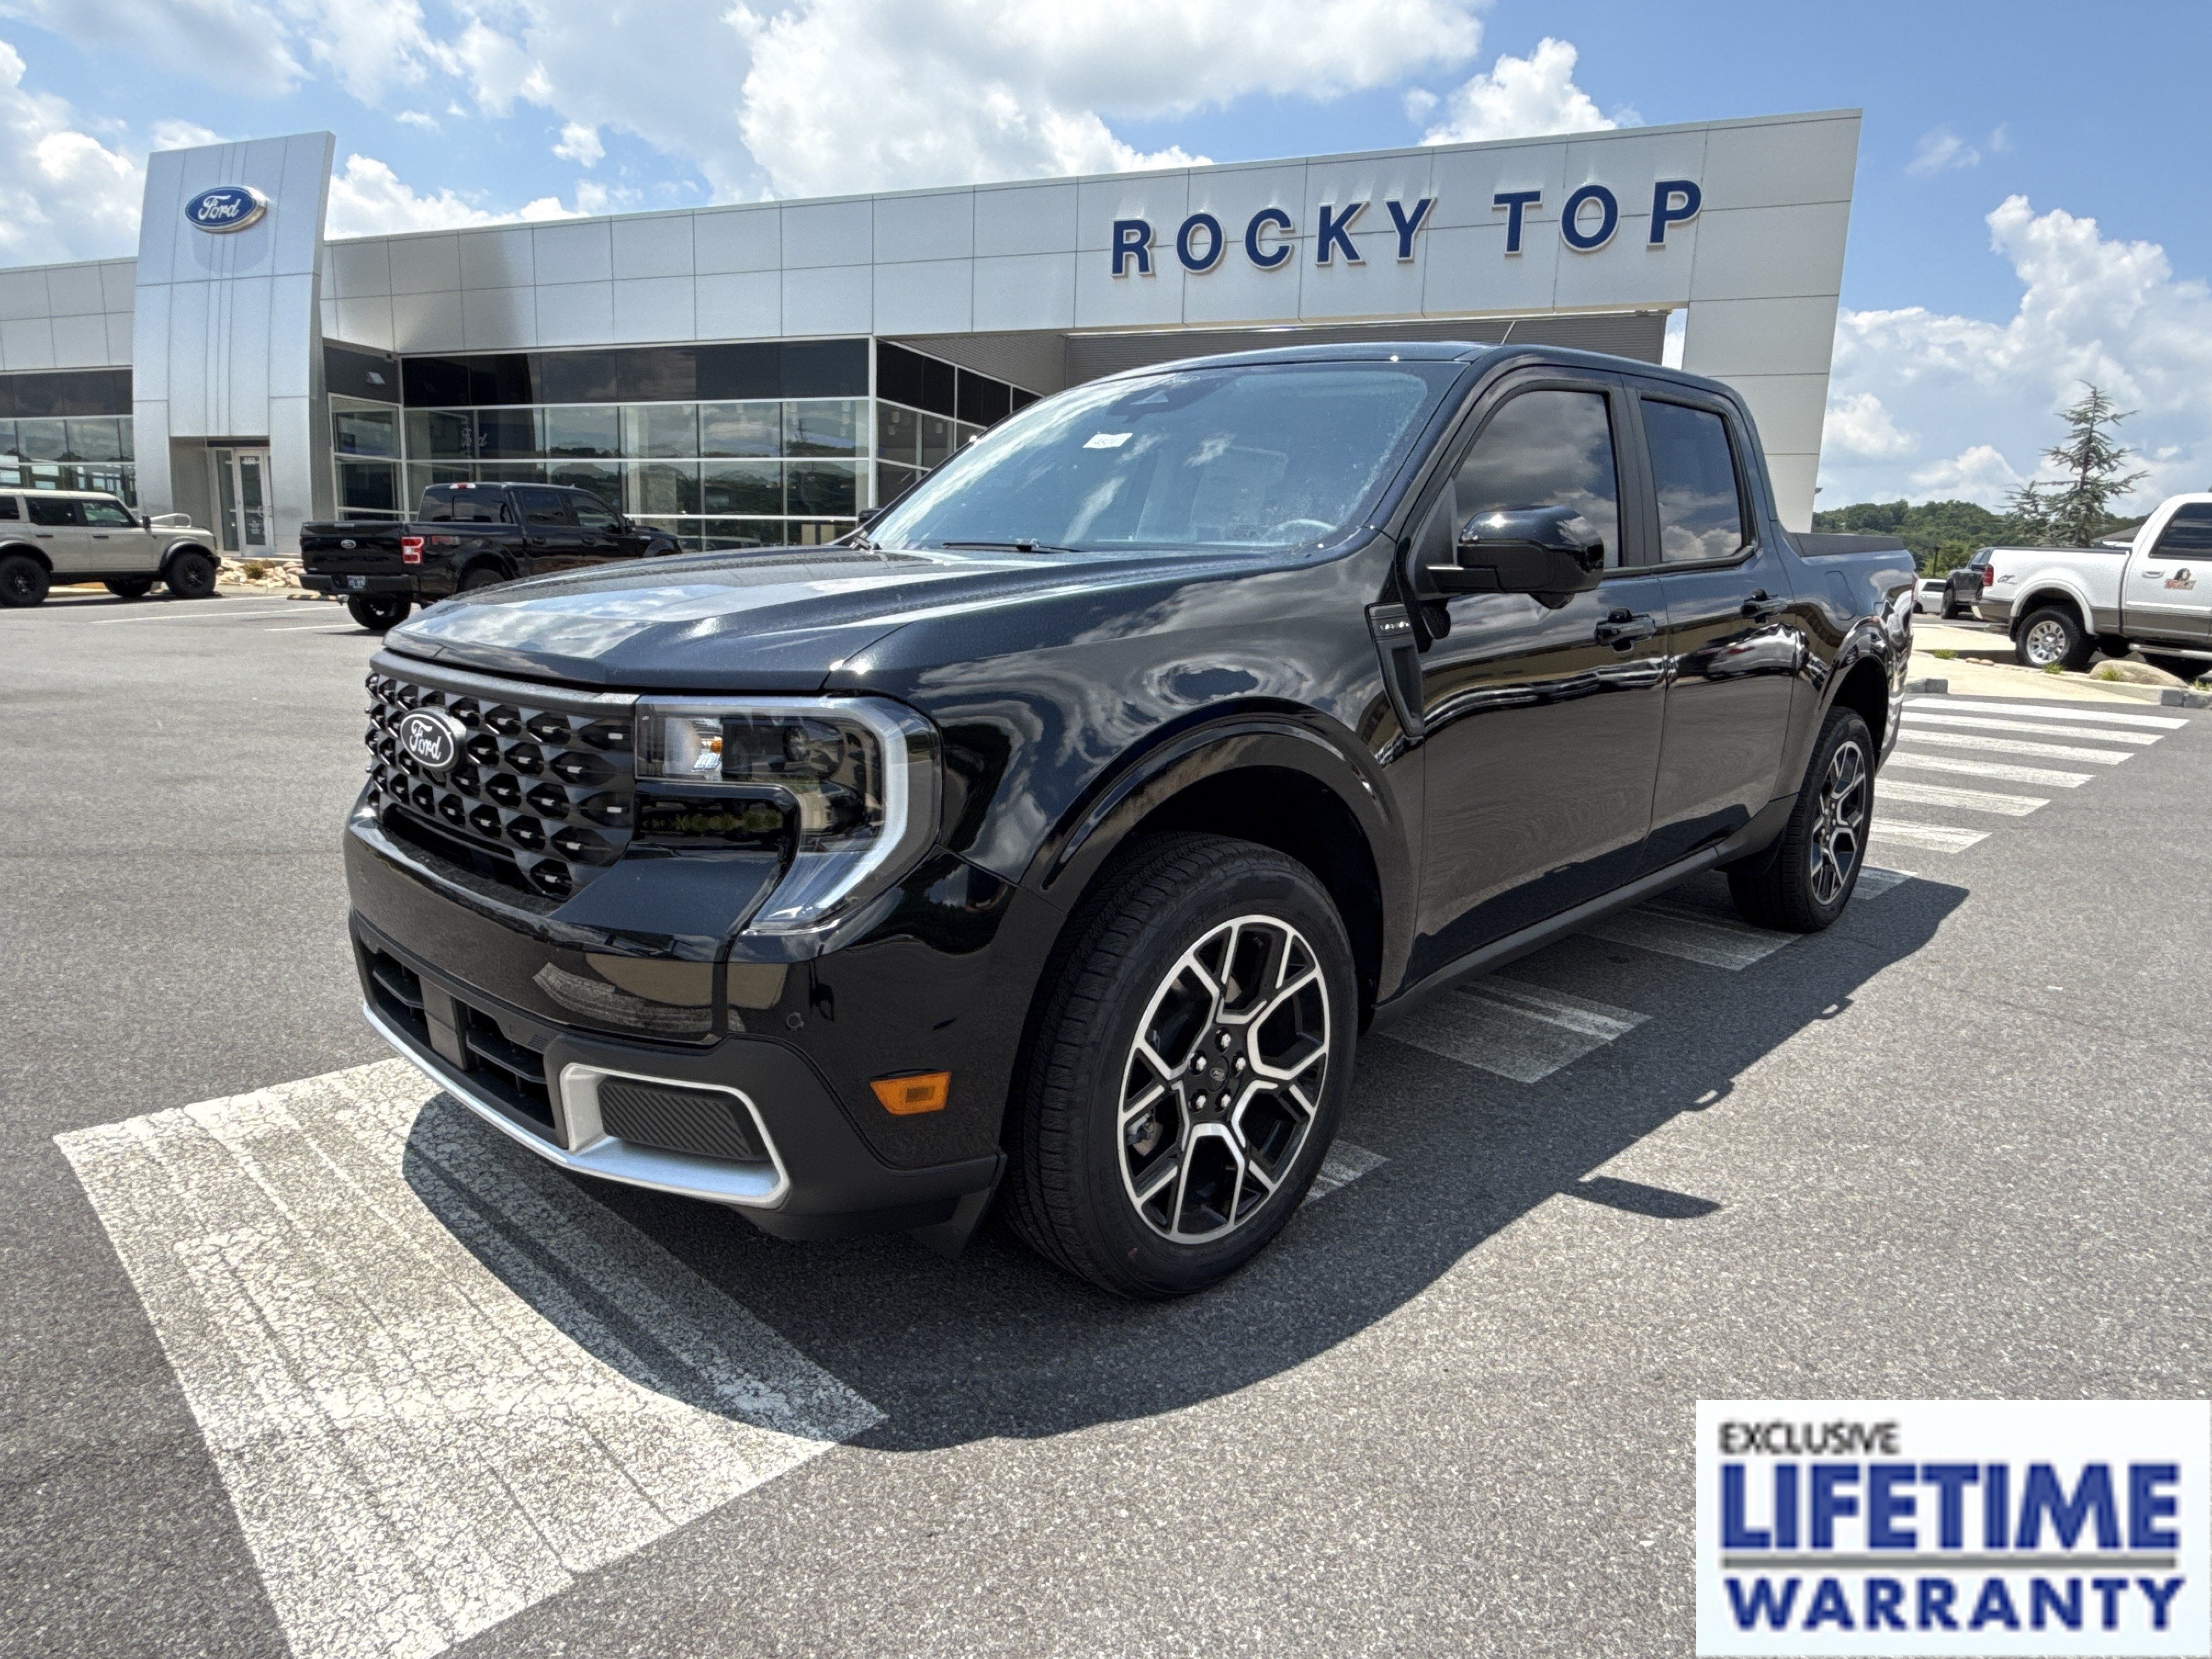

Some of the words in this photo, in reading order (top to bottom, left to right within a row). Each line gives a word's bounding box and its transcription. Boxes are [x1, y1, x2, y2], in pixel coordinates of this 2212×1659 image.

[198, 194, 241, 221] Ford
[1113, 199, 1431, 274] ROCKY
[1494, 180, 1701, 251] TOP
[409, 720, 442, 760] Ford
